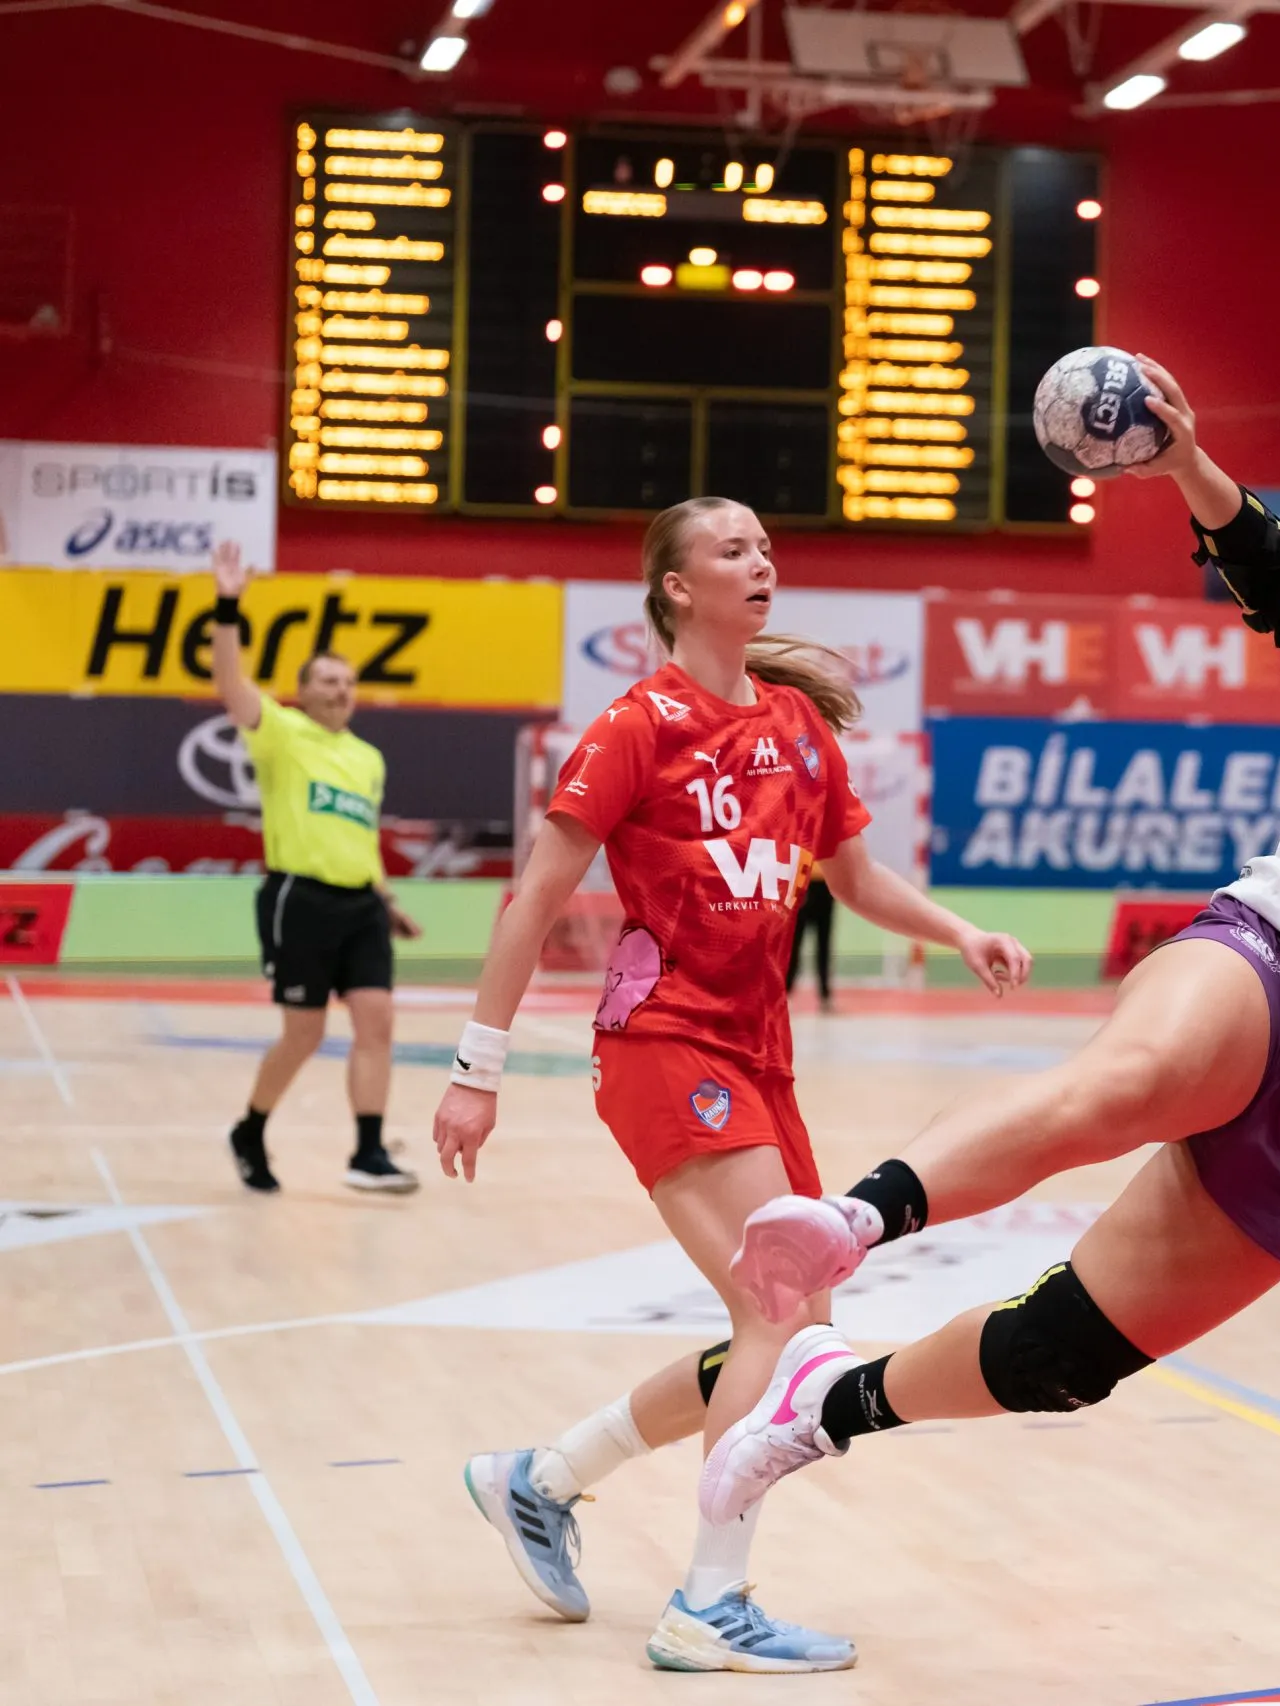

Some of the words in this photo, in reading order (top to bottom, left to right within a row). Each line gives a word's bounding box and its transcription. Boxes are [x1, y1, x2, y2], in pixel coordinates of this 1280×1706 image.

[1092, 360, 1129, 433] SELECT
[86, 582, 430, 686] Hertz
[954, 618, 1102, 683] VHE
[686, 774, 742, 833] 16
[709, 901, 759, 912] VERKVIT
